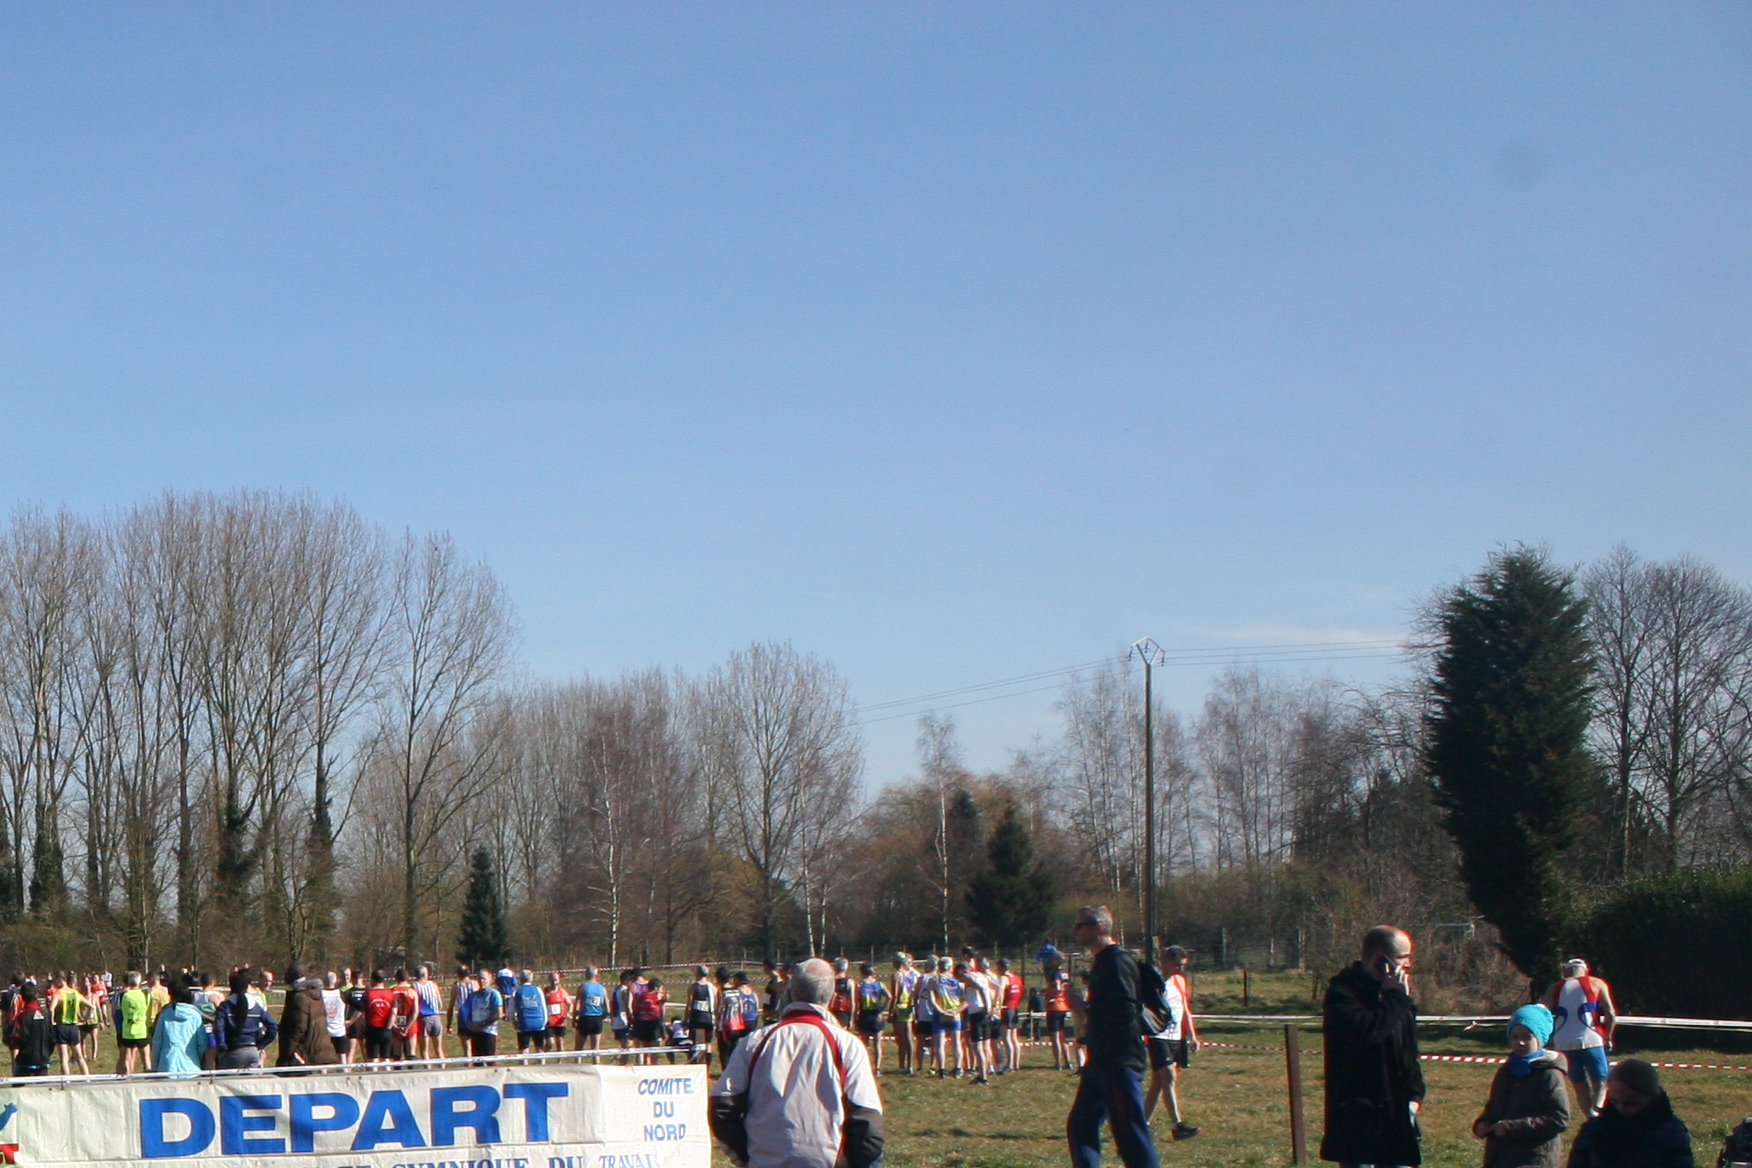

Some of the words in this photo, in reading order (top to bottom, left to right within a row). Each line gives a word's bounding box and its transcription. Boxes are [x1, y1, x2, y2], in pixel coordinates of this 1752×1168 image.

[636, 1077, 695, 1096] COMITE
[653, 1101, 675, 1119] DU
[138, 1081, 570, 1159] DEPART
[643, 1123, 687, 1142] NORD
